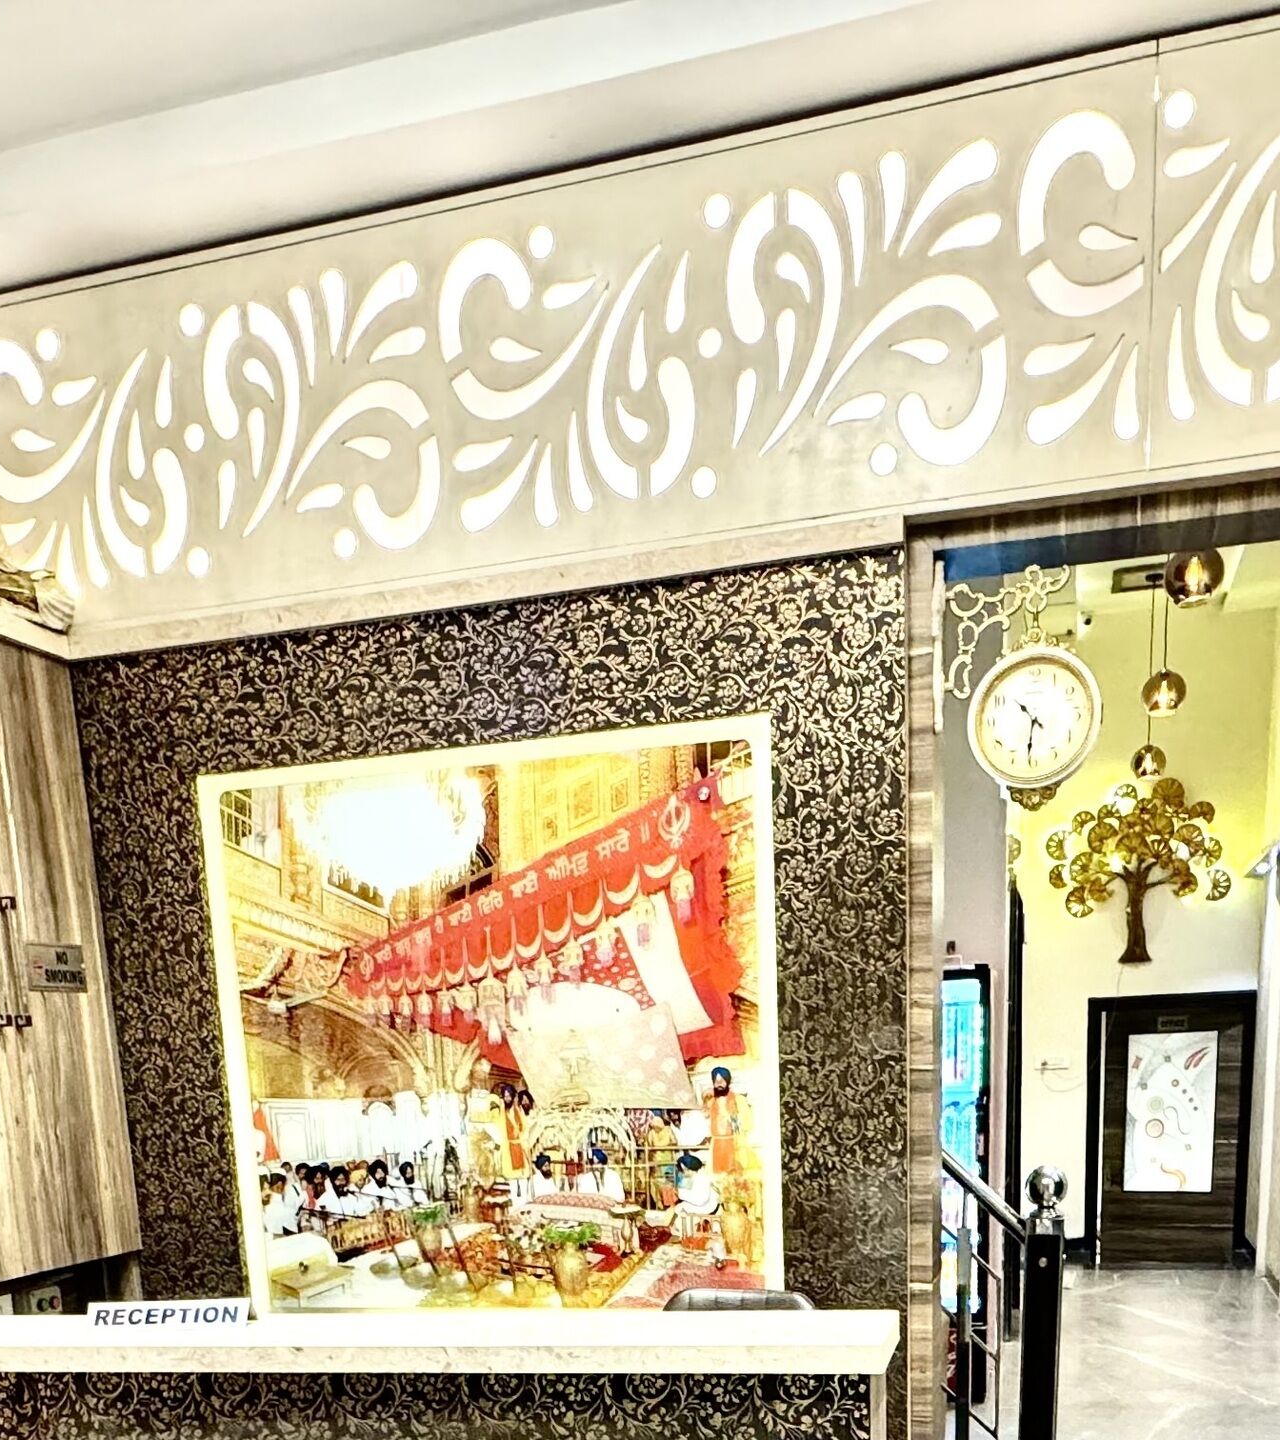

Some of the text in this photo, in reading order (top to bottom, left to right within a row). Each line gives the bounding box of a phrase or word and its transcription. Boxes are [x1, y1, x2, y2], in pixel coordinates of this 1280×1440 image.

[55, 950, 69, 966] NO
[44, 968, 86, 985] SMOKING
[94, 1306, 239, 1326] RECEPTION
